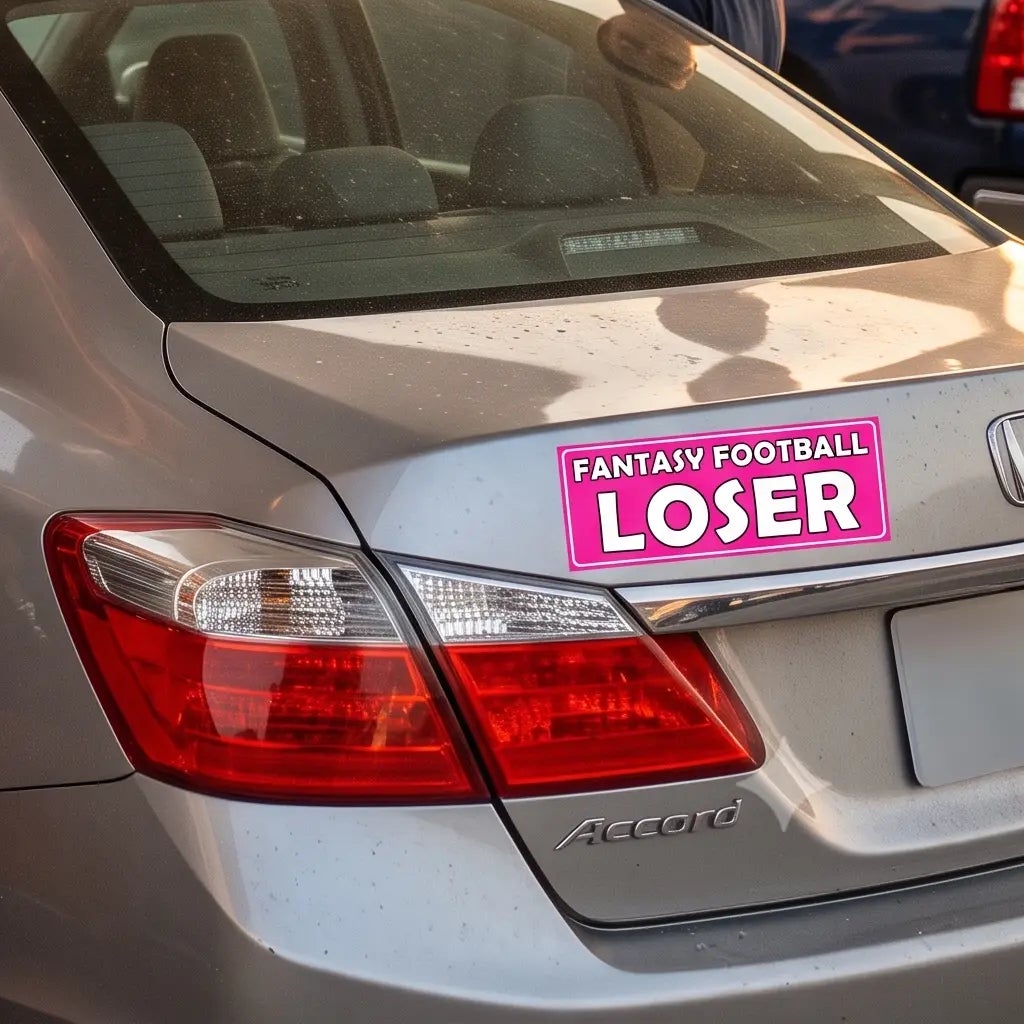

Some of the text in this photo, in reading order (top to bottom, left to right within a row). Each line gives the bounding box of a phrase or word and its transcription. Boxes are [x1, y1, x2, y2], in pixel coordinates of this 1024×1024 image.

[572, 432, 869, 482] FANTASY FOOTBALL
[596, 469, 860, 553] LOSER
[554, 798, 743, 850] Accord
